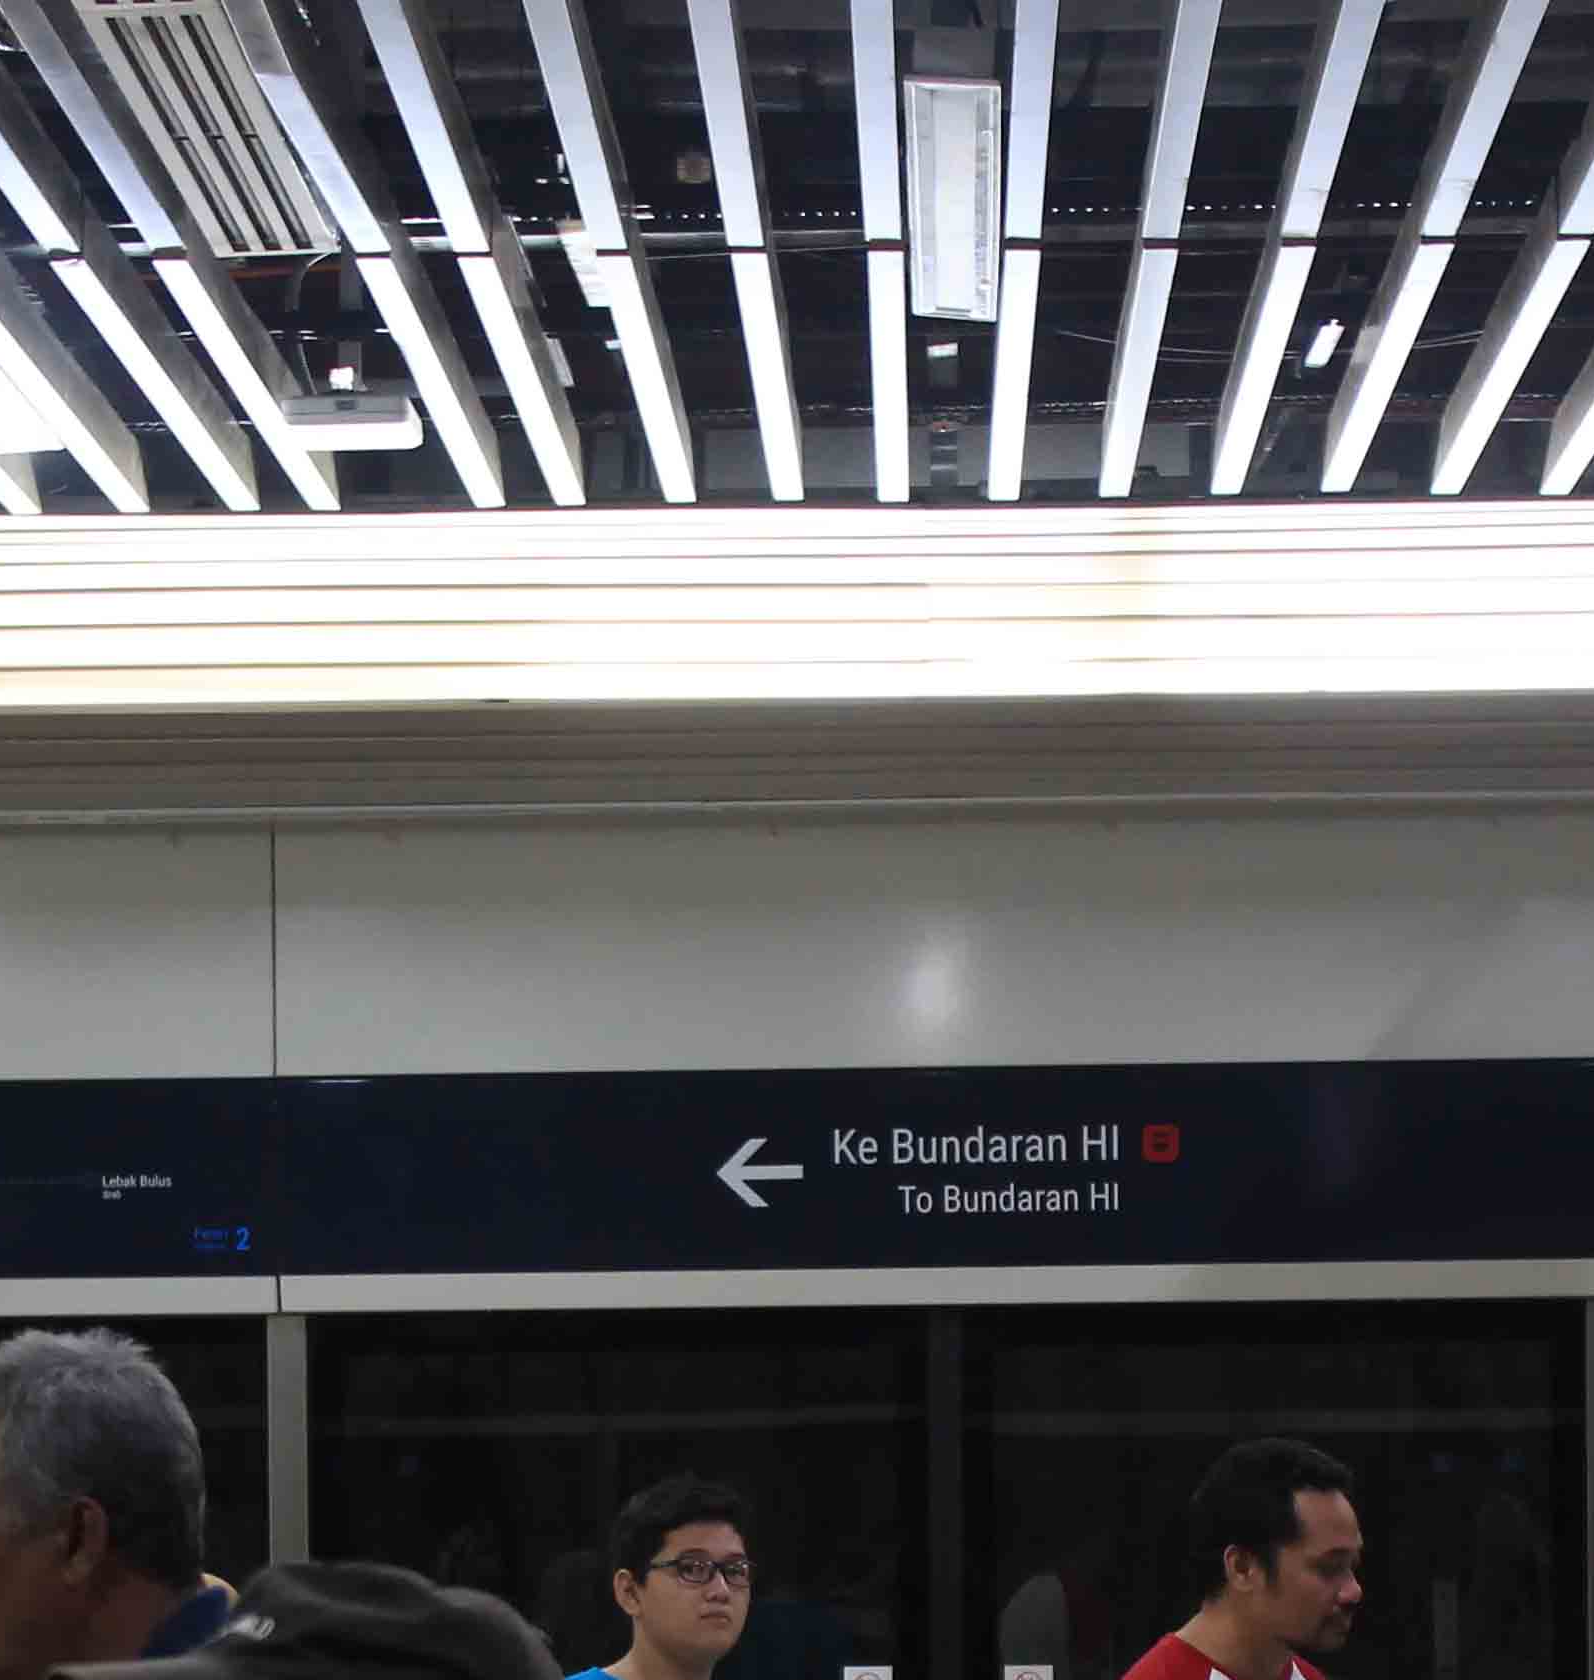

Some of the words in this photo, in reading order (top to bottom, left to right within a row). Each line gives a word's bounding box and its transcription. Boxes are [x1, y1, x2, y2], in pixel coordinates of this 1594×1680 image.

[834, 1129, 877, 1164] Ke
[893, 1126, 1066, 1163] Bundaran
[1083, 1125, 1118, 1160] HI
[898, 1186, 932, 1213] To
[944, 1183, 1078, 1212] Bundaran
[1091, 1183, 1118, 1210] HI
[236, 1226, 250, 1251] 2
